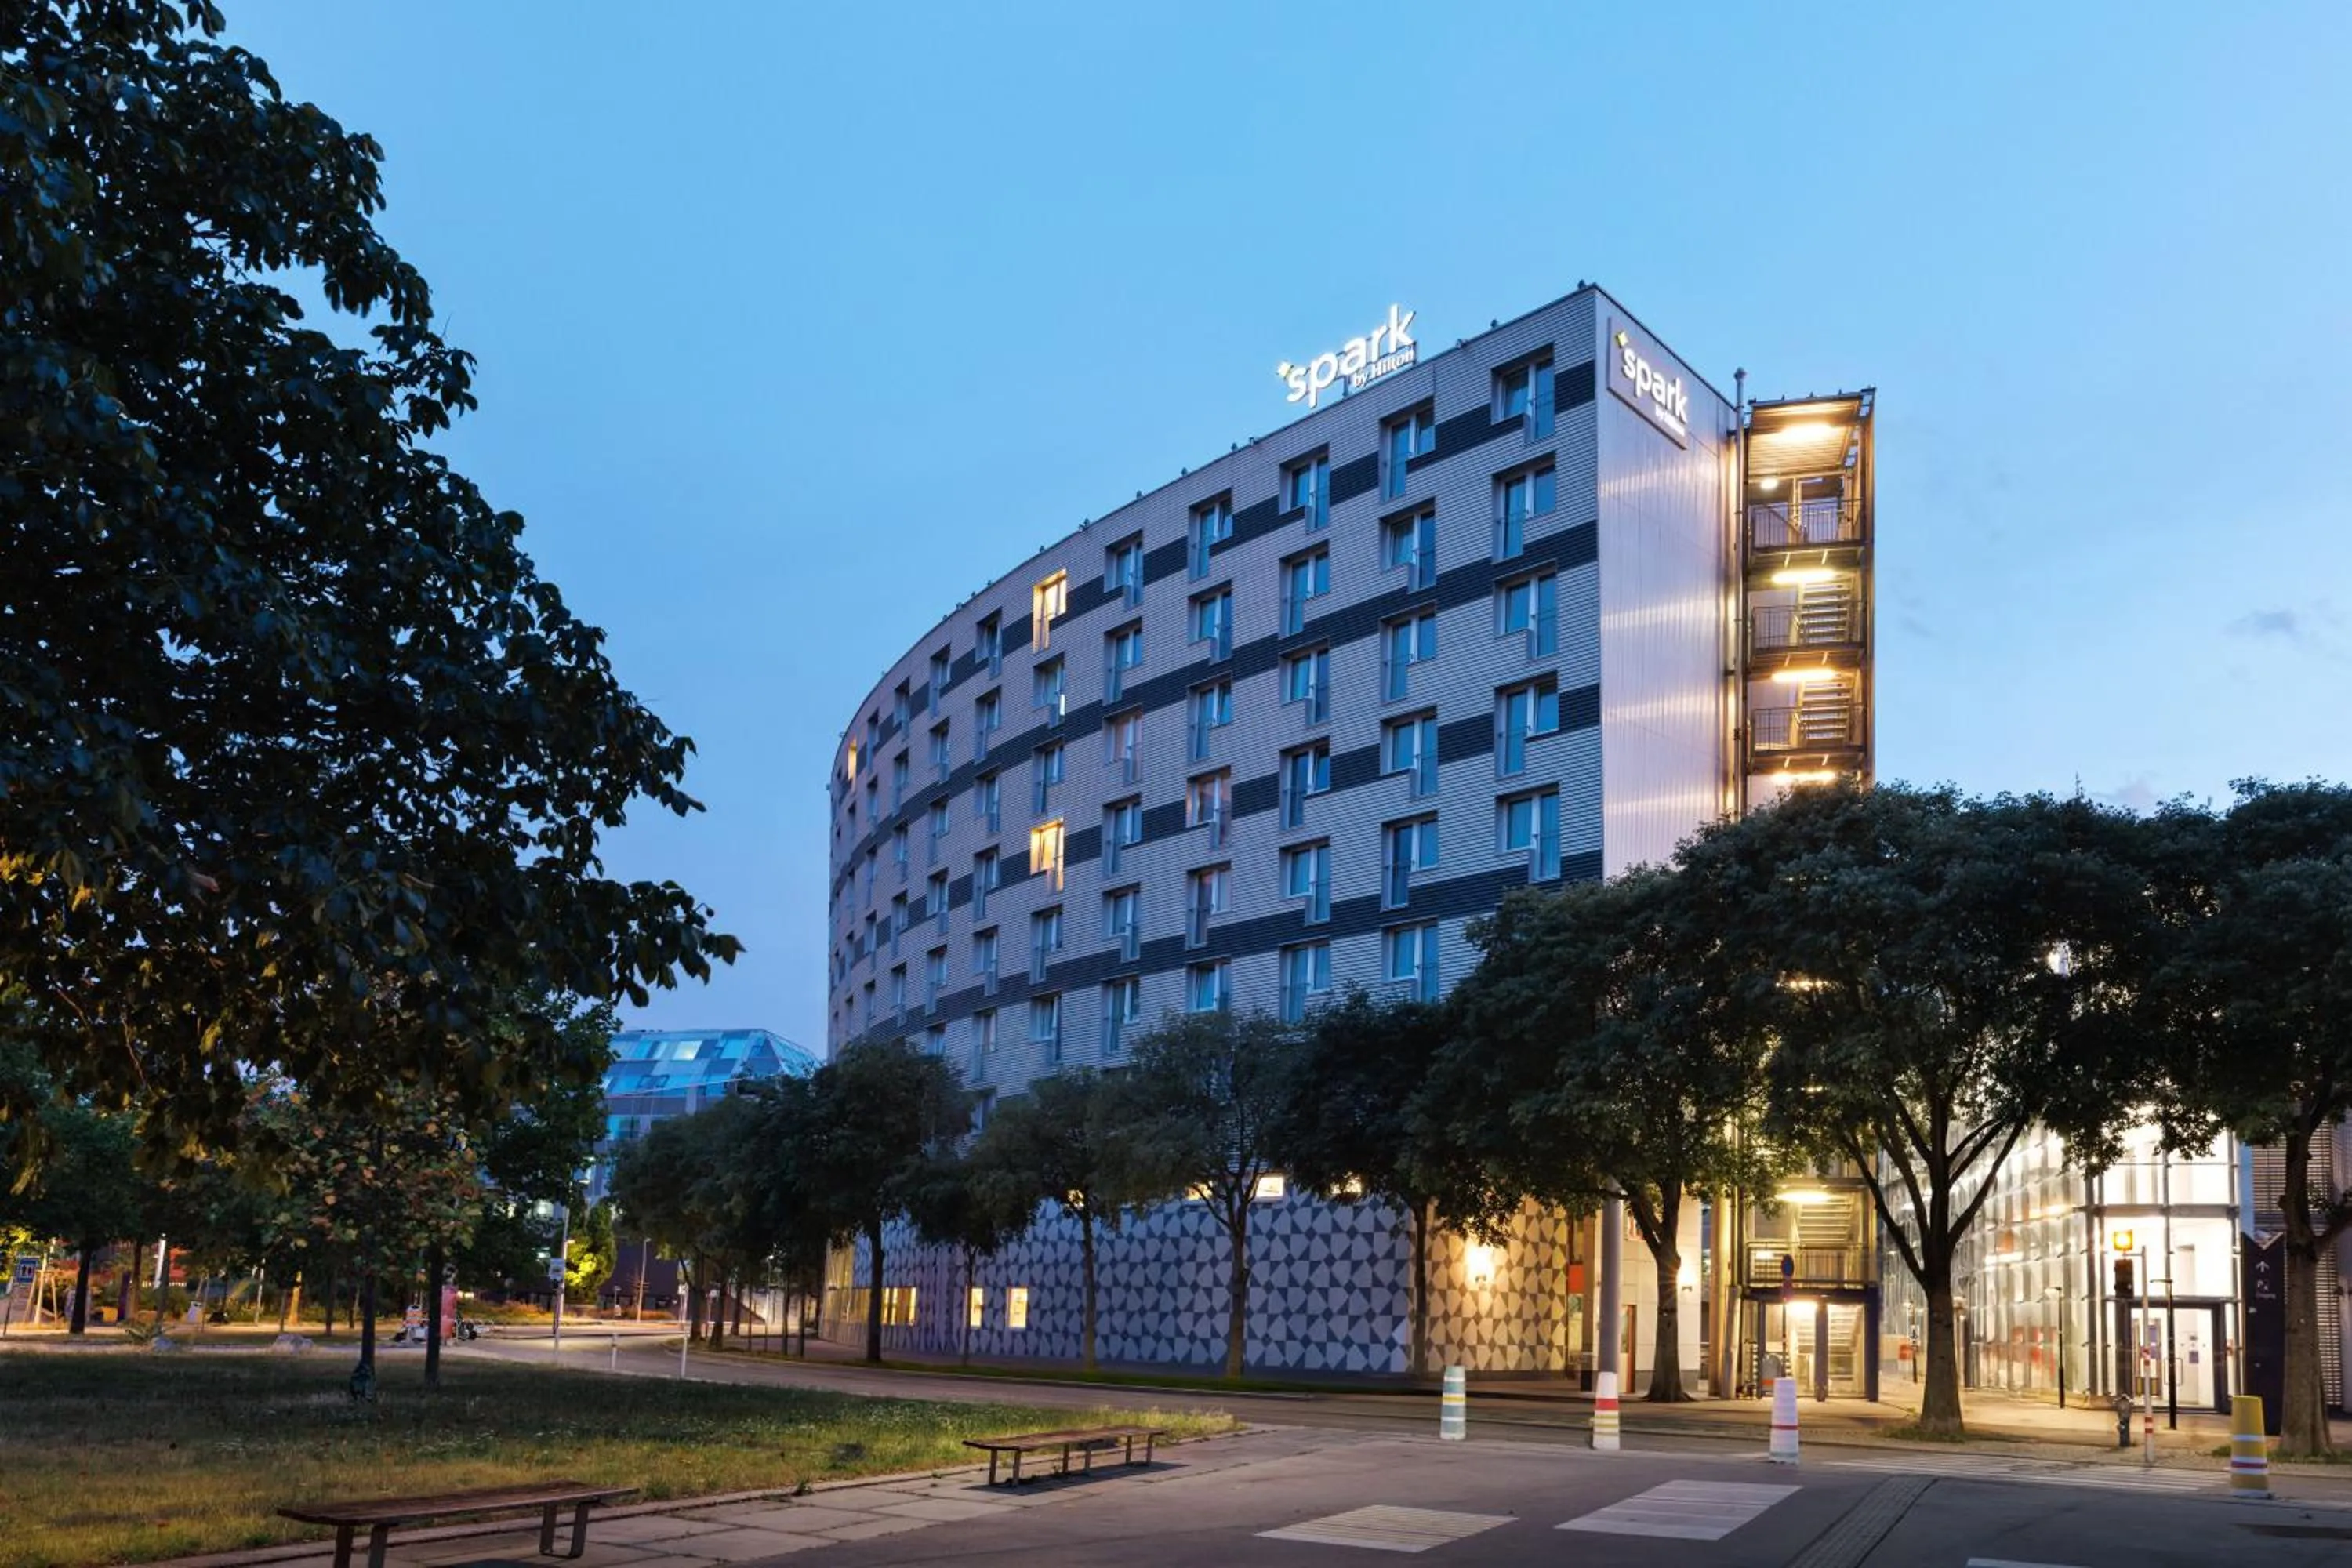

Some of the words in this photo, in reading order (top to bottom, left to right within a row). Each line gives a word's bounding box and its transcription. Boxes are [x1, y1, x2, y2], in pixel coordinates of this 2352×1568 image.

[1287, 303, 1416, 408] spark
[1354, 371, 1370, 390] by
[1371, 349, 1415, 379] Hilton
[1624, 348, 1687, 424] spark
